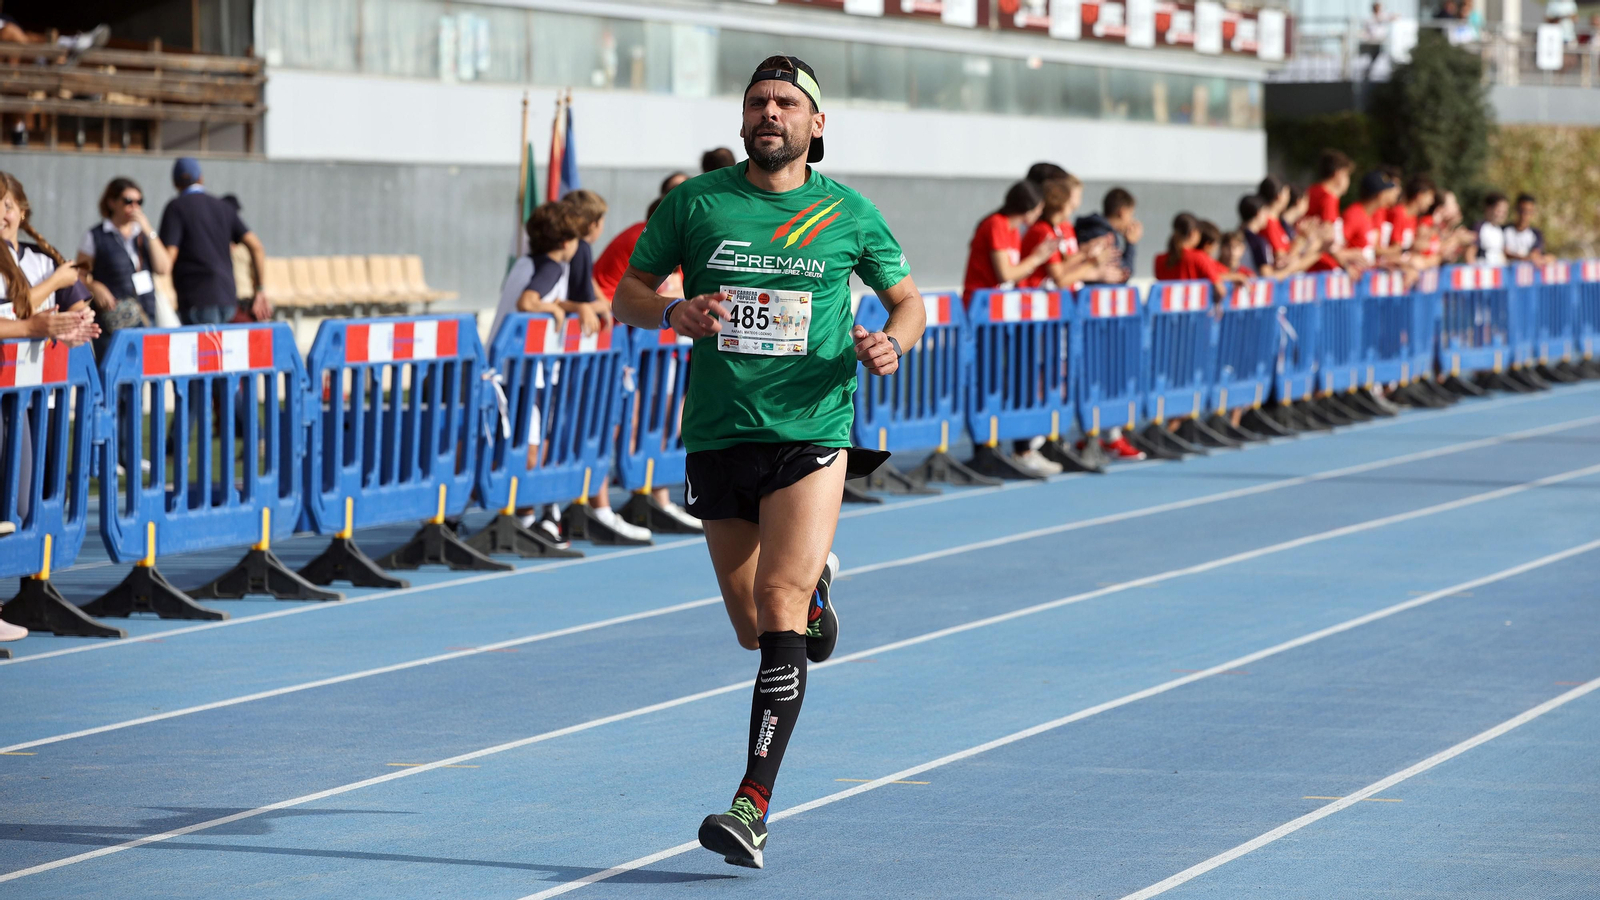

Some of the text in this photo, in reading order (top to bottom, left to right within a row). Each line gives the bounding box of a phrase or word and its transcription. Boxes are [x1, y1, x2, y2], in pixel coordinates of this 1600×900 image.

[707, 240, 825, 273] EPREMAIN
[804, 270, 822, 278] CEUTA
[729, 304, 770, 330] 485
[754, 709, 772, 756] COMPRES
[759, 724, 776, 758] SPORT
